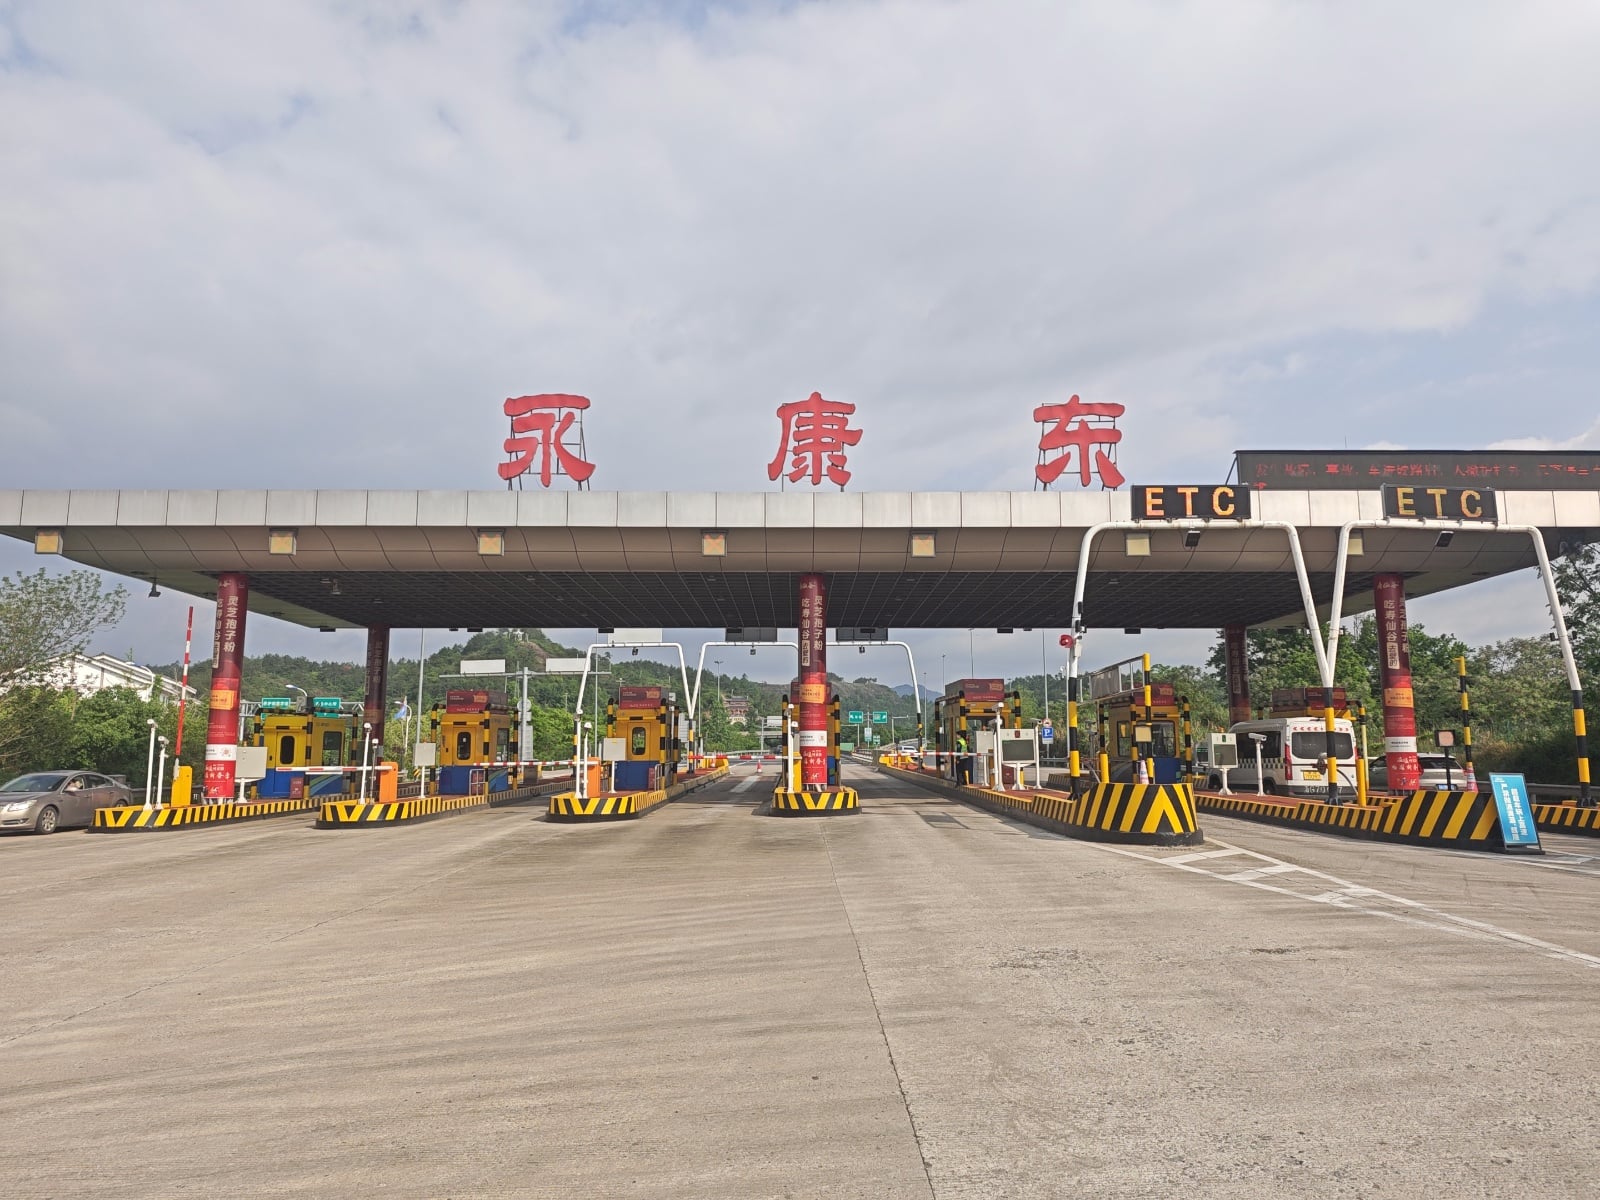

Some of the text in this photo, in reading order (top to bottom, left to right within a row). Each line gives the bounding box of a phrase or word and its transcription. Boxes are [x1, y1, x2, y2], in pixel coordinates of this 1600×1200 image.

[498, 392, 1126, 489] 永康东
[1145, 487, 1235, 516] ETC
[1396, 487, 1482, 518] ETC
[222, 595, 239, 653] 灵芝孢子粉
